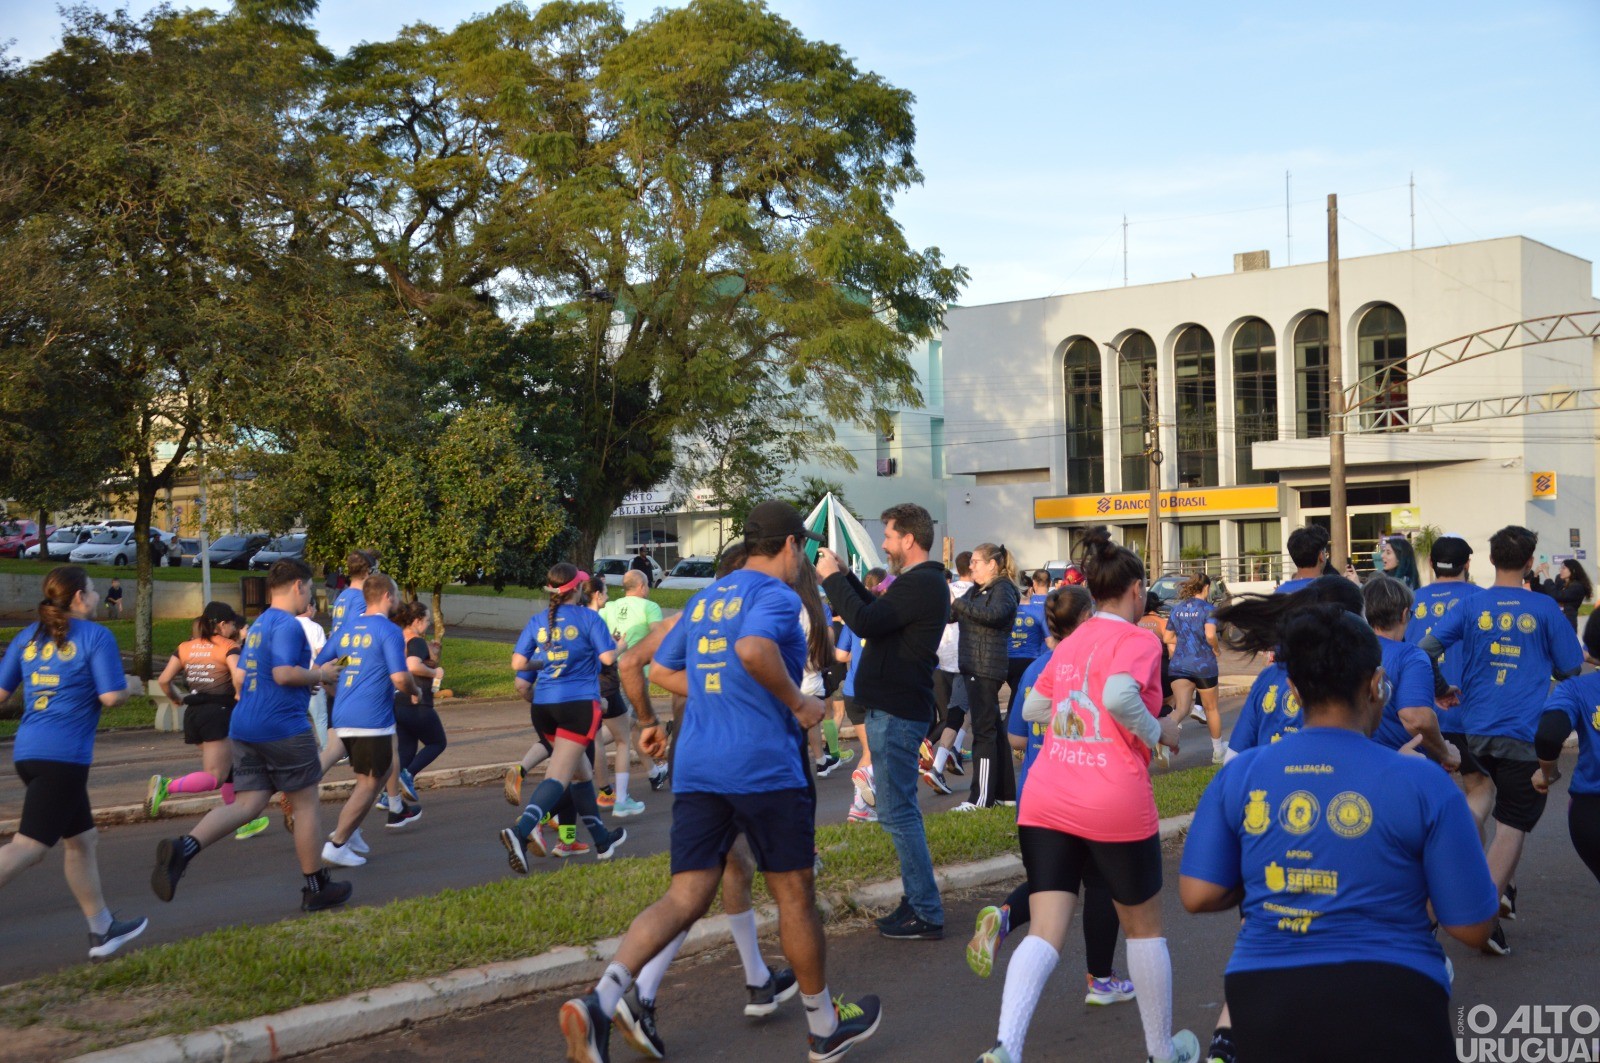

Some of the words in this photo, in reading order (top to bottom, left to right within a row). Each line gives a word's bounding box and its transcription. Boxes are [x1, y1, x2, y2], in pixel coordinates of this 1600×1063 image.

[1114, 499, 1150, 510] BANCO
[1169, 496, 1207, 508] BRASIL
[1049, 742, 1107, 767] Pilates
[1285, 764, 1334, 774] REALIZAÇÃO:
[1287, 873, 1338, 889] SEBERI
